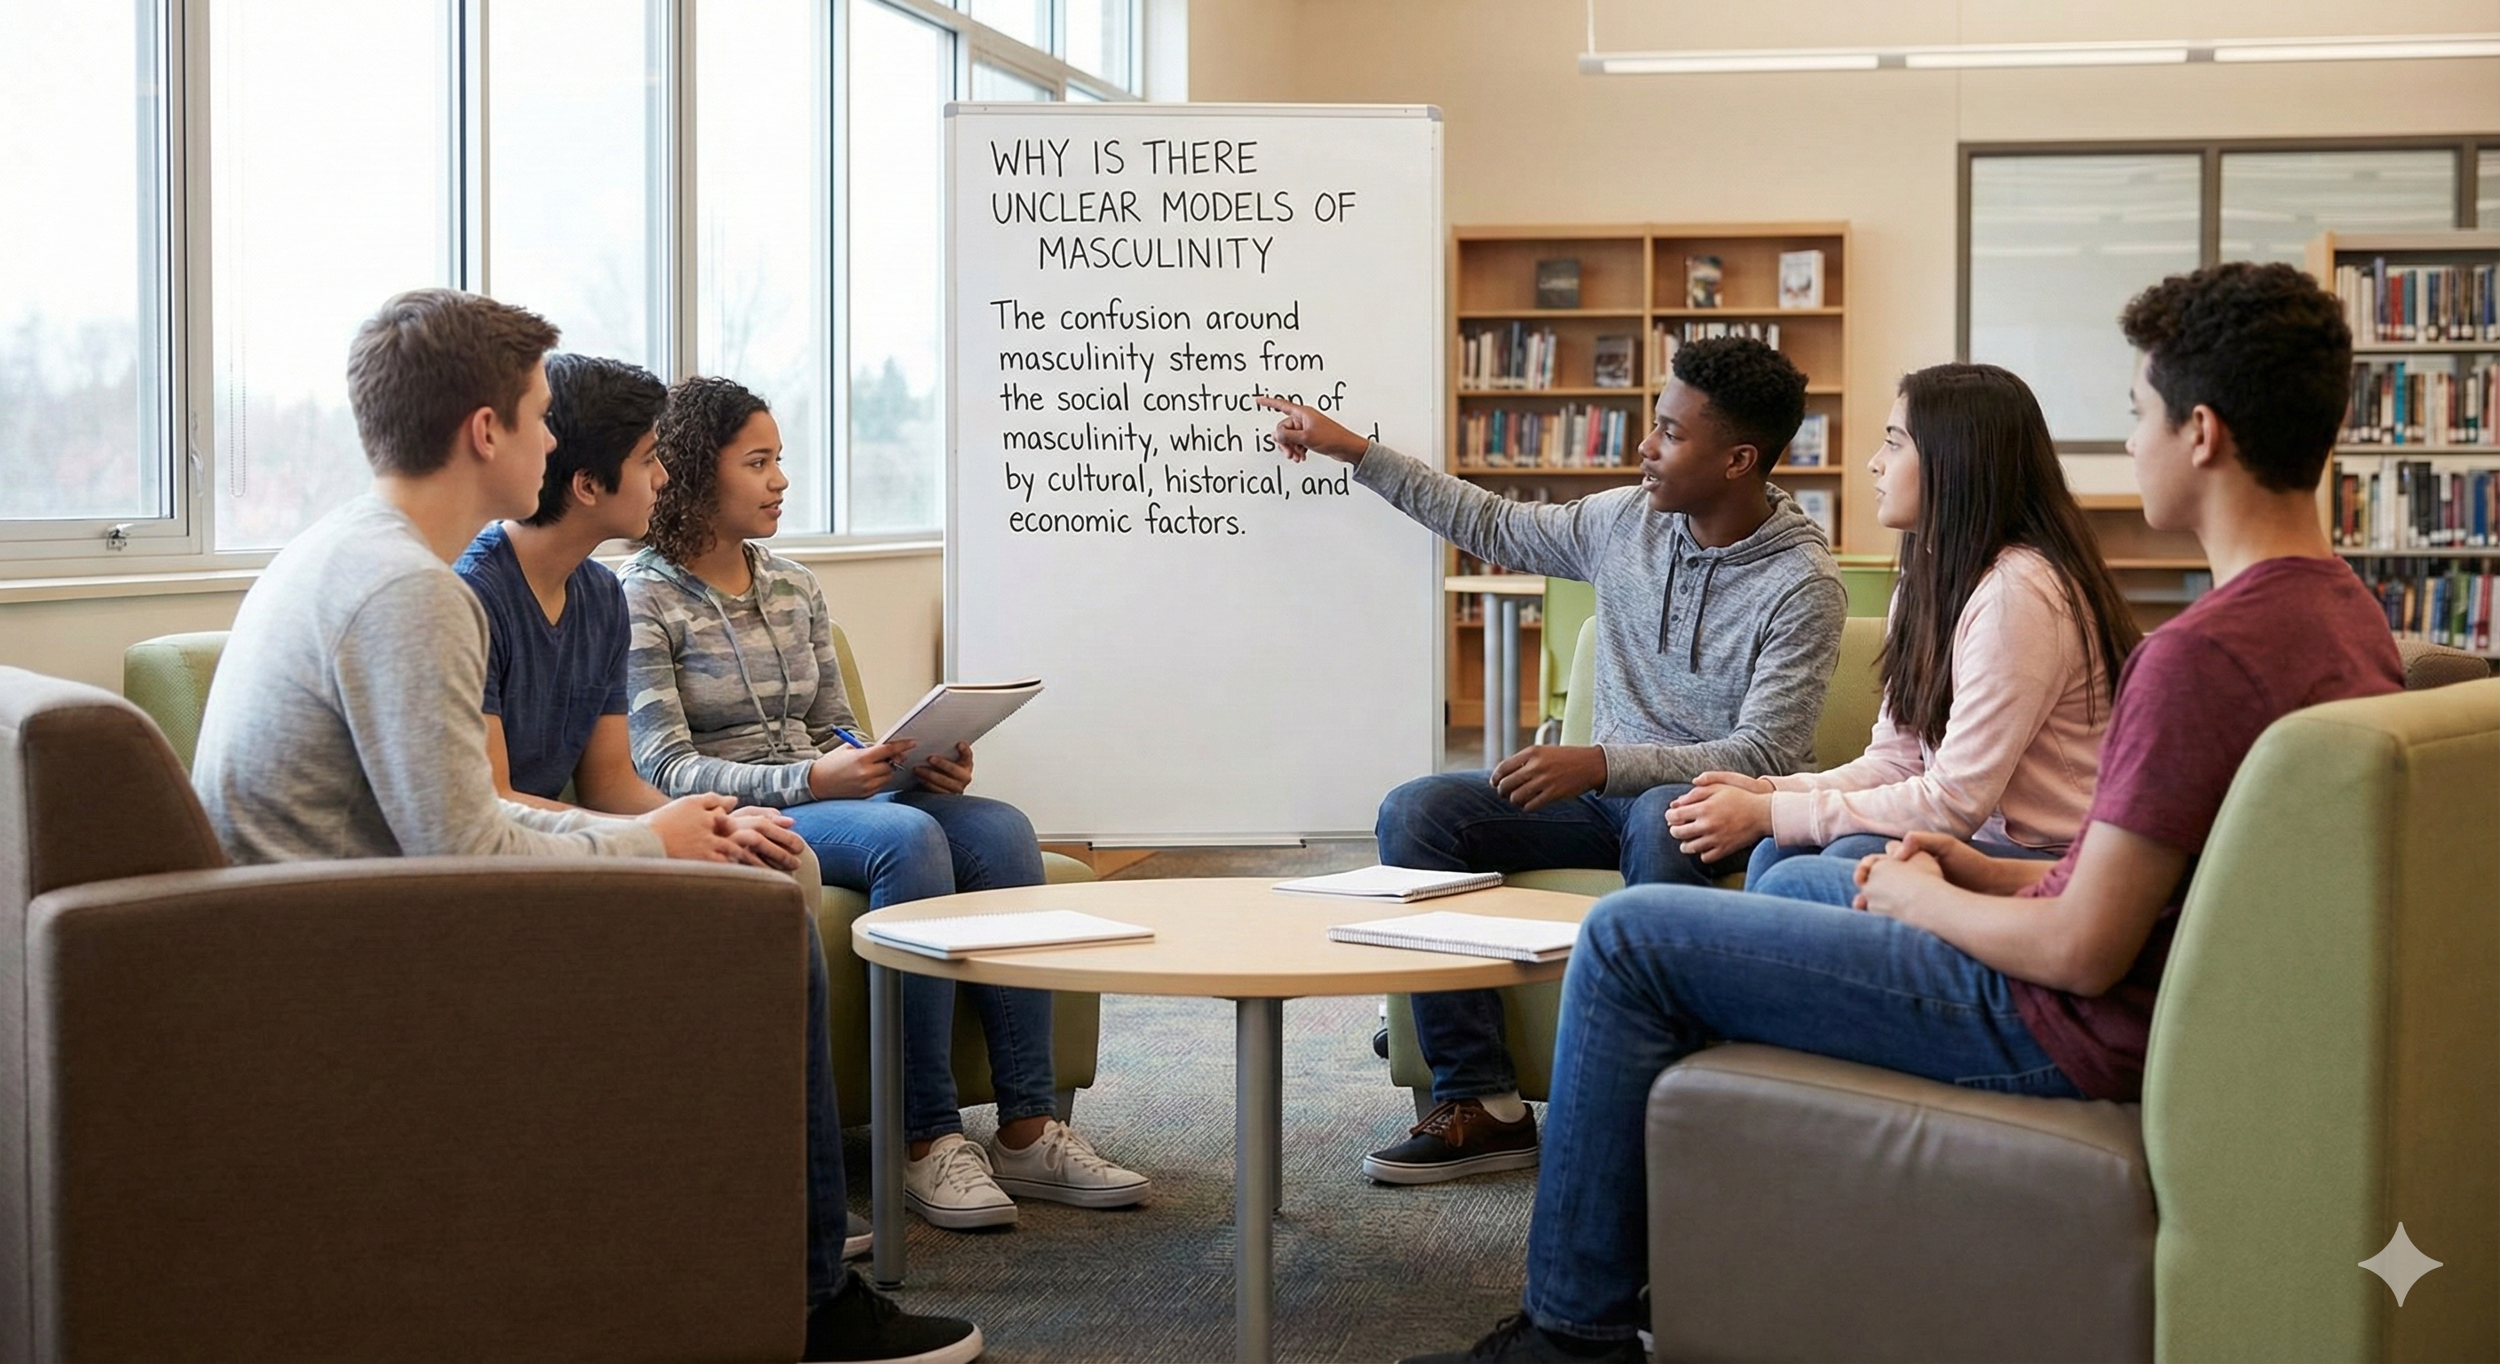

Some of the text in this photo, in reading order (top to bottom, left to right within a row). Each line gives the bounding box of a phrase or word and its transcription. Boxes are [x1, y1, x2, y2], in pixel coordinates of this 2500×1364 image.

[990, 138, 1258, 178] WHY IS THERE
[992, 190, 1356, 225] UNCLEAR MODELS OF
[1039, 236, 1274, 274] MASCULINITY
[989, 297, 1300, 331] The confusion around
[999, 339, 1324, 383] masculinity stems from
[999, 382, 1045, 412] the
[1057, 381, 1129, 412] social
[1317, 381, 1347, 412] of
[1003, 421, 1276, 462] masculinity, which is
[1005, 461, 1350, 503] by cultural, historical, and
[1009, 501, 1246, 536] economic factors.
